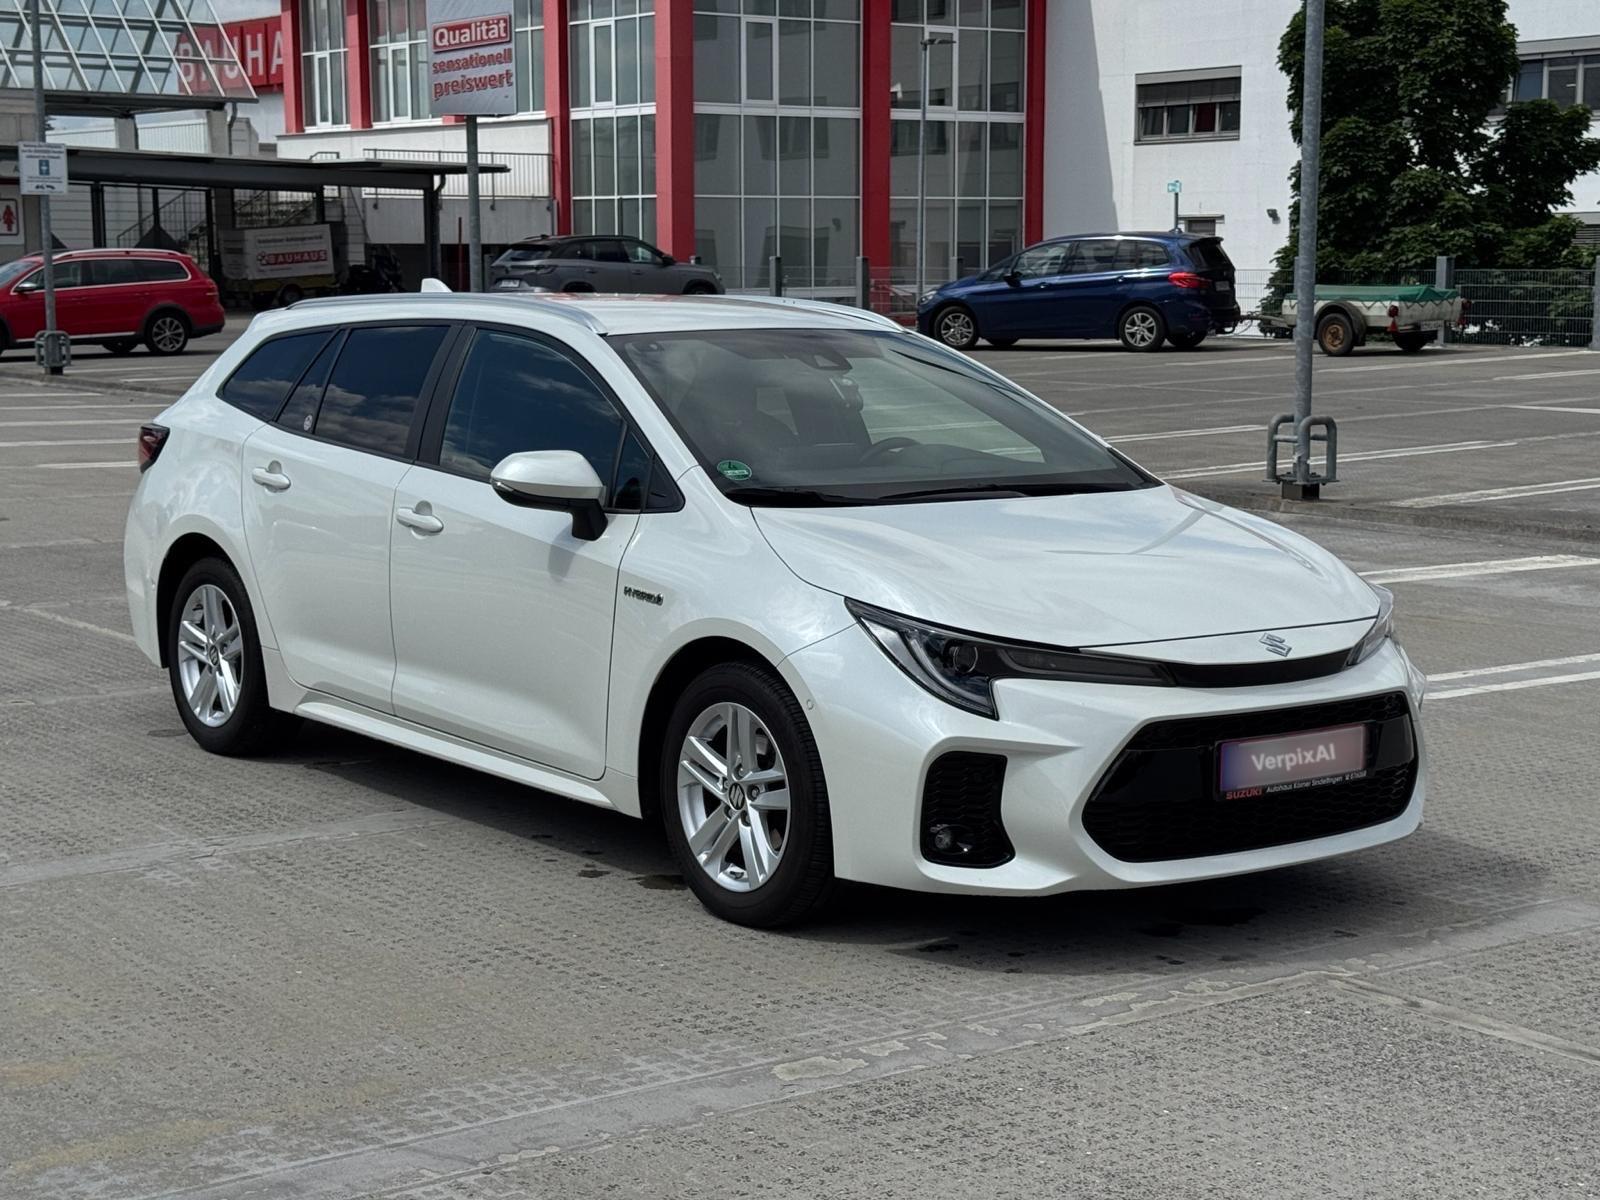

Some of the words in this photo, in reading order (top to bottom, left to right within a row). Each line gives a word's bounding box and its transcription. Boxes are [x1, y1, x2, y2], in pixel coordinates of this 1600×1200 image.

[434, 19, 506, 47] Qualität
[432, 48, 513, 74] sensationell
[433, 69, 514, 100] preiswert
[270, 250, 326, 264] BAUHAUS
[1225, 788, 1263, 800] SUZUKI
